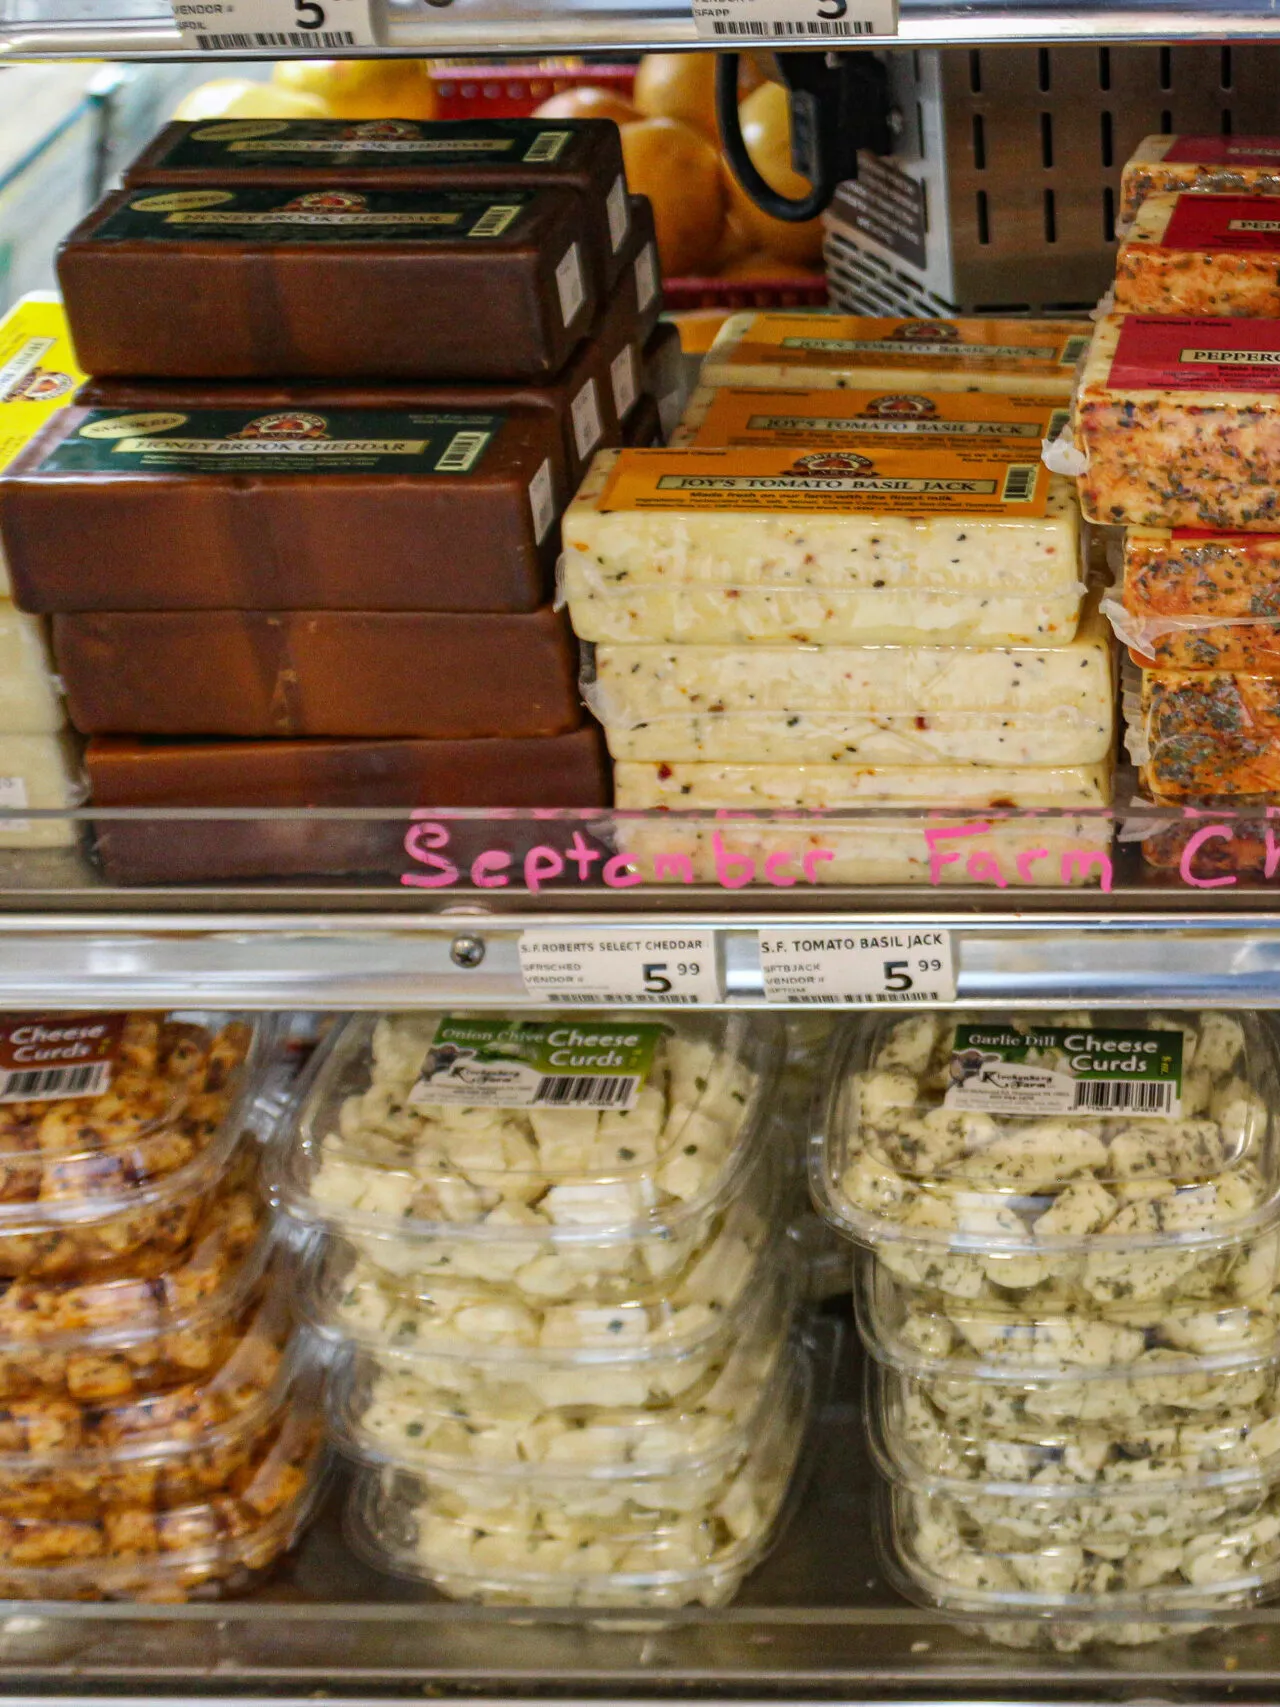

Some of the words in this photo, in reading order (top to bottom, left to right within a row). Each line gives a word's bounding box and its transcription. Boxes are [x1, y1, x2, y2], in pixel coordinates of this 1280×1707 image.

[295, 0, 325, 29] 5
[826, 420, 907, 431] TOMATO
[135, 440, 215, 451] HONEY
[216, 441, 294, 452] BROOK
[298, 441, 406, 452] CHEDDAR
[678, 478, 736, 488] JOY'S
[746, 478, 843, 489] TOMATO
[853, 480, 915, 490] BASIL
[919, 481, 977, 493] JACK
[401, 822, 835, 893] September
[923, 822, 1113, 893] Farm
[599, 941, 641, 952] SELECT
[645, 940, 703, 951] CHEDDAR
[792, 938, 855, 952] TOMATO
[860, 935, 904, 949] BASIL
[907, 933, 943, 949] JACK
[525, 975, 573, 983] VENDOR
[642, 963, 673, 994] 5
[676, 962, 701, 976] 99
[766, 976, 814, 985] VENDOR
[883, 960, 913, 992] 5
[918, 959, 942, 972] 99
[9, 1025, 107, 1045] Cheese
[442, 1029, 493, 1041] Onion
[547, 1029, 641, 1047] Cheese
[968, 1033, 1021, 1047] Garlic
[1025, 1034, 1056, 1047] Dill
[1063, 1034, 1159, 1054] Cheese
[13, 1042, 93, 1063] Curds
[549, 1049, 624, 1067] Curds
[1071, 1054, 1148, 1072] Curds
